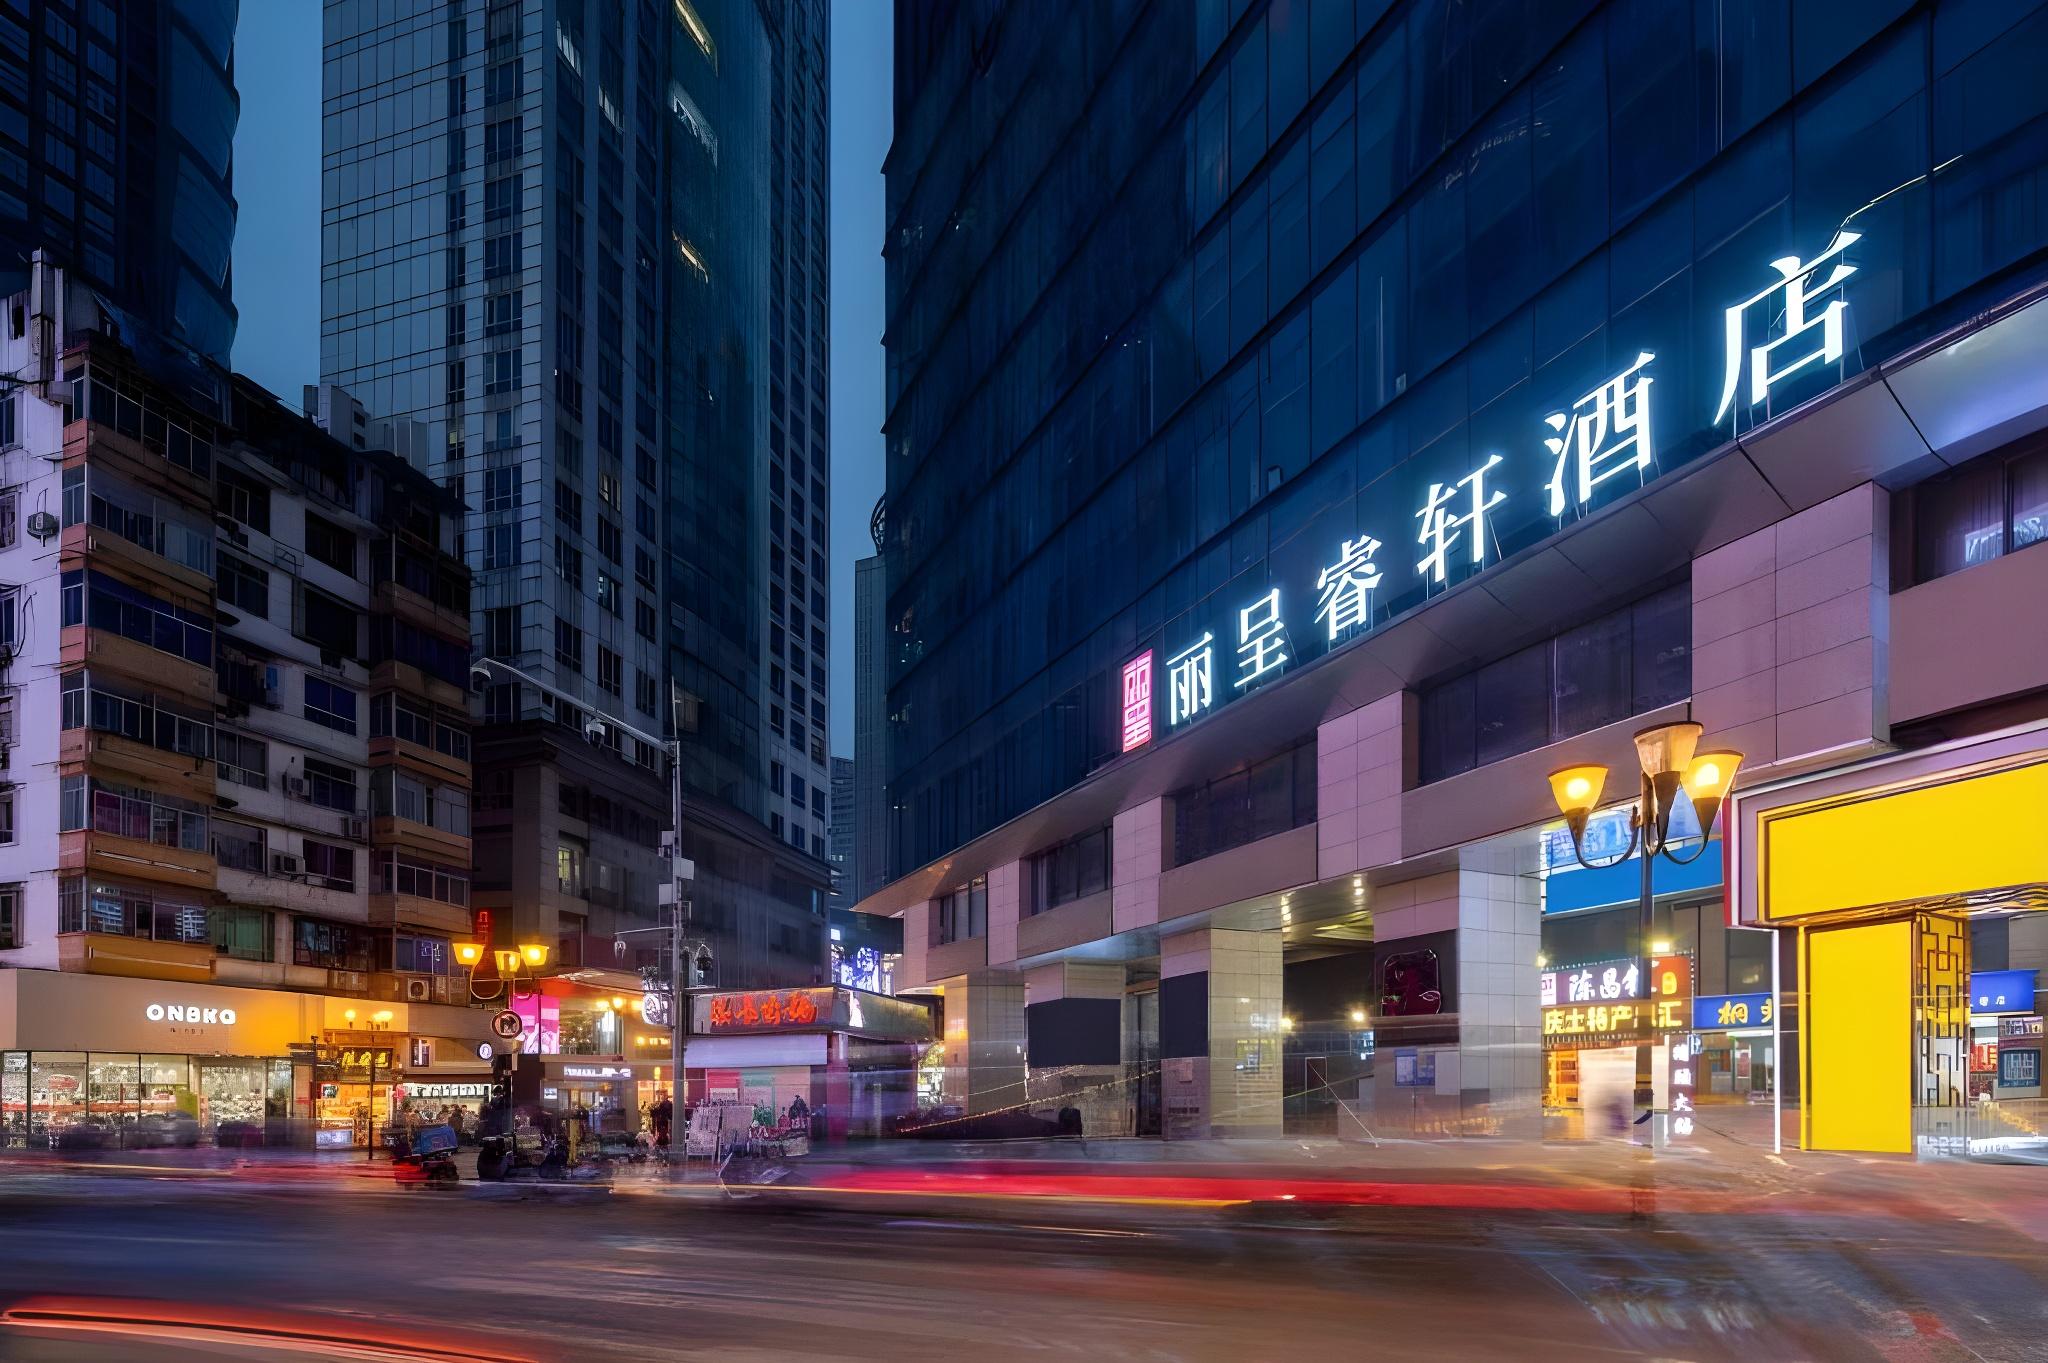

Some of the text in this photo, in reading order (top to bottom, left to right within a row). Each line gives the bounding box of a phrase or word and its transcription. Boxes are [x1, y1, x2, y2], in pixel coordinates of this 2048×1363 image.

[1166, 231, 1863, 725] 丽呈睿轩酒店
